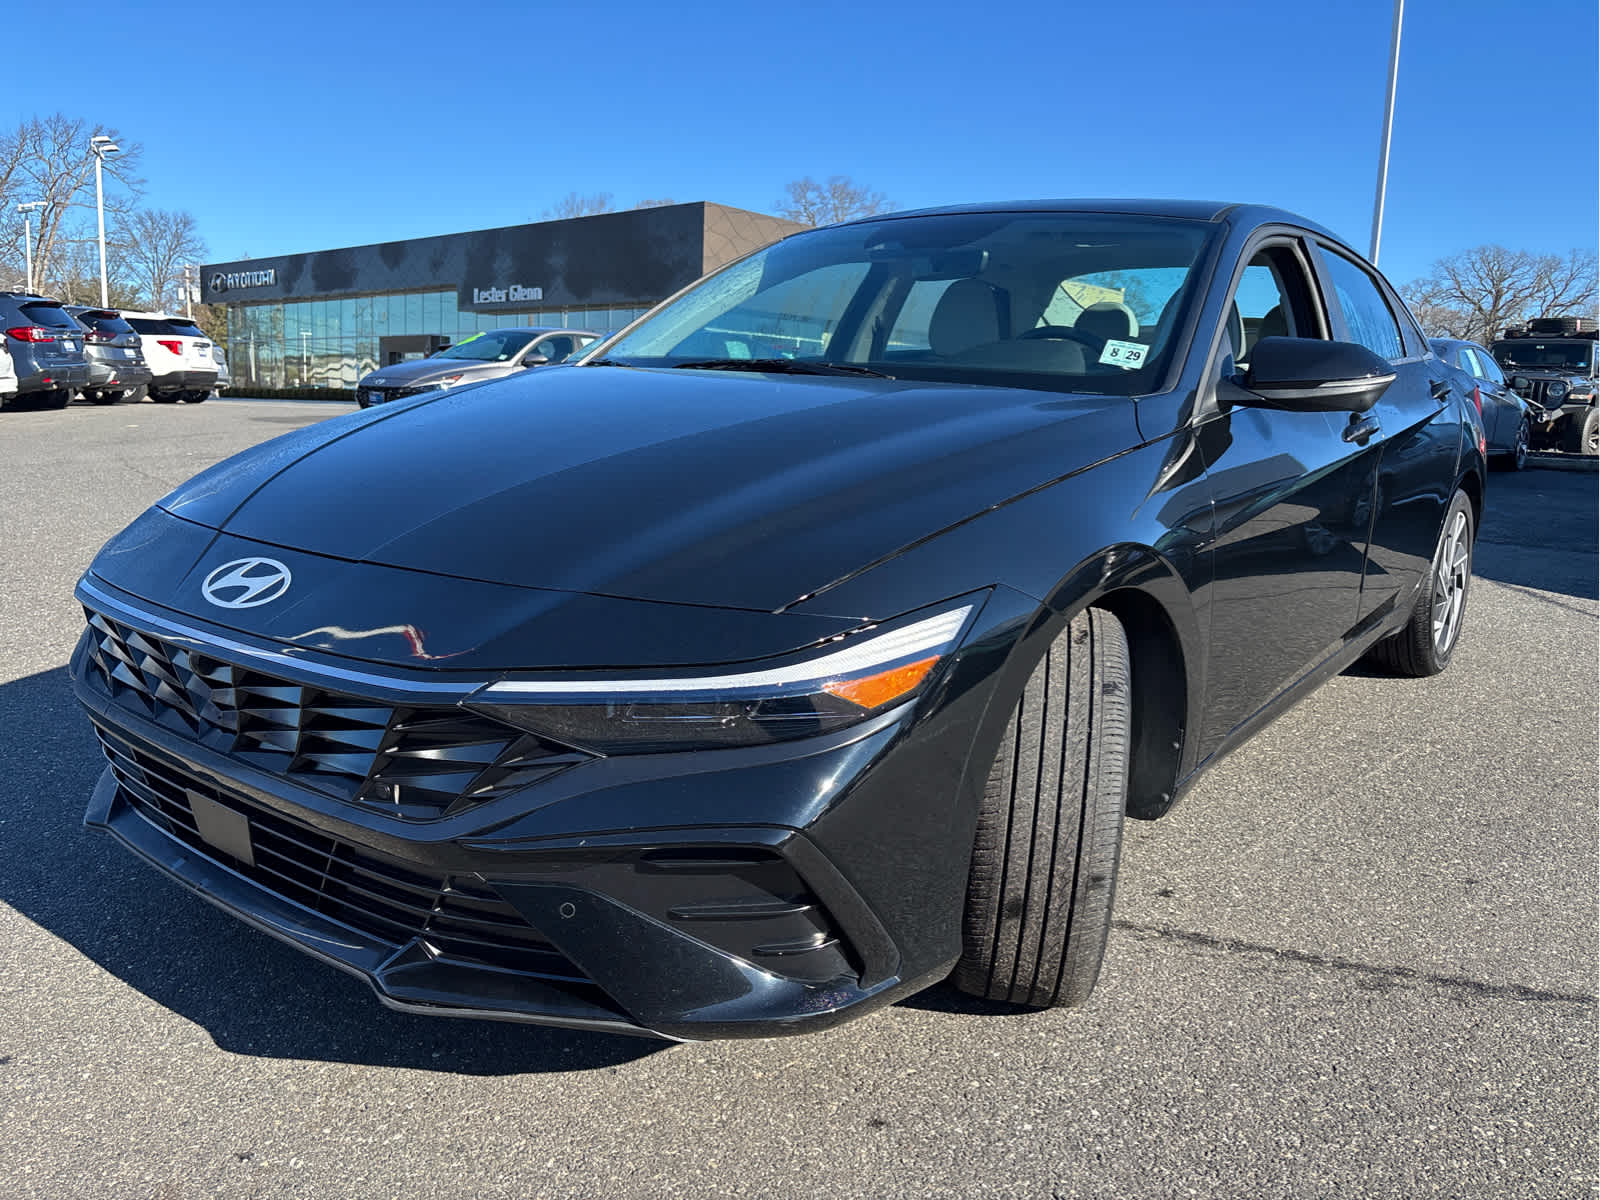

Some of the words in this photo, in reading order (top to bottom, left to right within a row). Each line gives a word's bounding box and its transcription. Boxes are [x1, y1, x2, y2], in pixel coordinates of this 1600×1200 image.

[473, 287, 508, 304] Lester
[510, 284, 543, 301] Glenn
[1110, 347, 1120, 358] 8
[1125, 350, 1141, 361] 29
